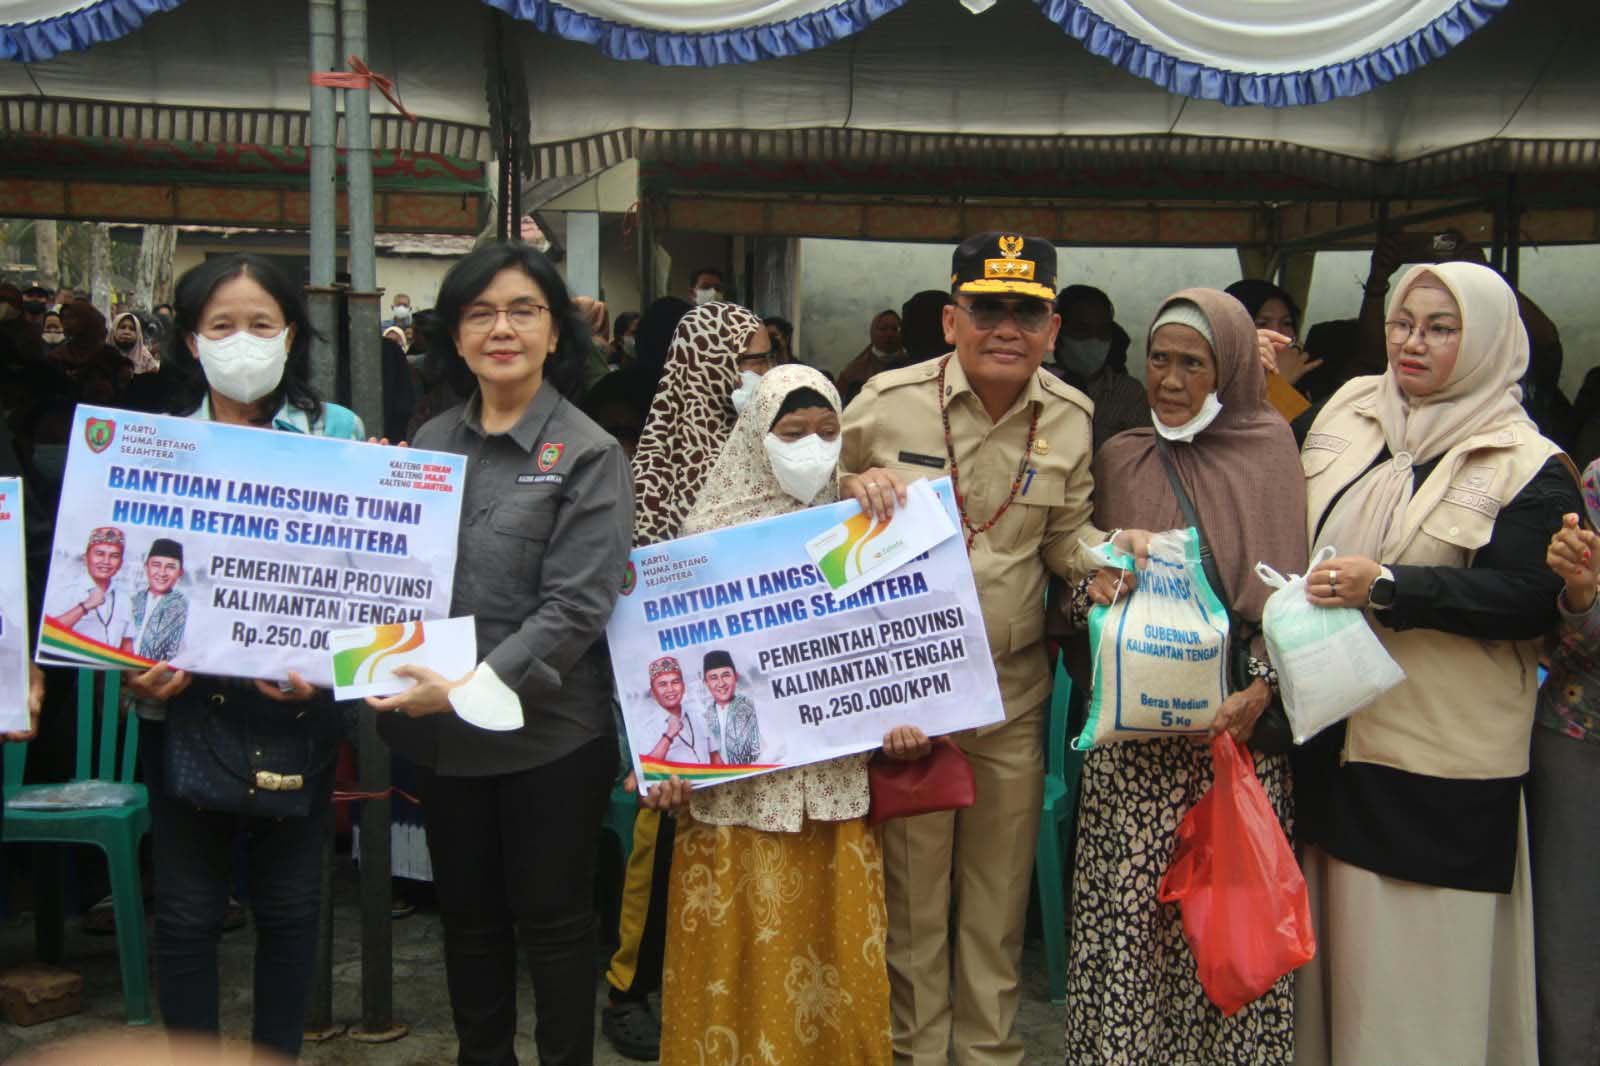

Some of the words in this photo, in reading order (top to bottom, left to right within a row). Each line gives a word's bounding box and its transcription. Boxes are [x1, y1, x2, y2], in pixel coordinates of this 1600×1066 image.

[123, 423, 157, 435] KARTU
[120, 445, 176, 460] SEJAHTERA
[121, 435, 154, 446] HUMA
[155, 439, 197, 451] BETANG
[108, 465, 221, 501] BANTUAN
[227, 480, 349, 517] LANGSUNG
[355, 496, 422, 525] TUNAI
[112, 500, 184, 530] HUMA
[190, 509, 279, 541] BETANG
[284, 520, 408, 556] SEJAHTERA
[640, 554, 670, 567] KARTU
[643, 564, 671, 577] HUMA
[672, 556, 708, 570] BETANG
[210, 555, 338, 589] PEMERINTAH
[343, 571, 433, 599] PROVINSI
[645, 570, 693, 587] SEJAHTERA
[643, 580, 745, 622] BANTUAN
[747, 563, 825, 598] LANGS
[212, 588, 340, 620] KALIMANTAN
[347, 602, 423, 625] TENGAH
[231, 621, 331, 650] Rp.250.00
[658, 618, 724, 651] HUMA
[725, 599, 809, 637] BETANG
[1144, 624, 1201, 645] GUBERNUR
[758, 627, 876, 671] PEMERINTAH
[879, 607, 965, 644] PROVINSI
[1126, 639, 1184, 660] KALIMANTAN
[1185, 645, 1218, 662] TENGAH
[771, 656, 889, 699] KALIMANTAN
[892, 638, 965, 671] TENGAH
[799, 673, 952, 726] Rp.250.000/KPM
[1140, 693, 1169, 709] Beras
[1172, 697, 1208, 710] Medium
[1161, 711, 1173, 727] 5
